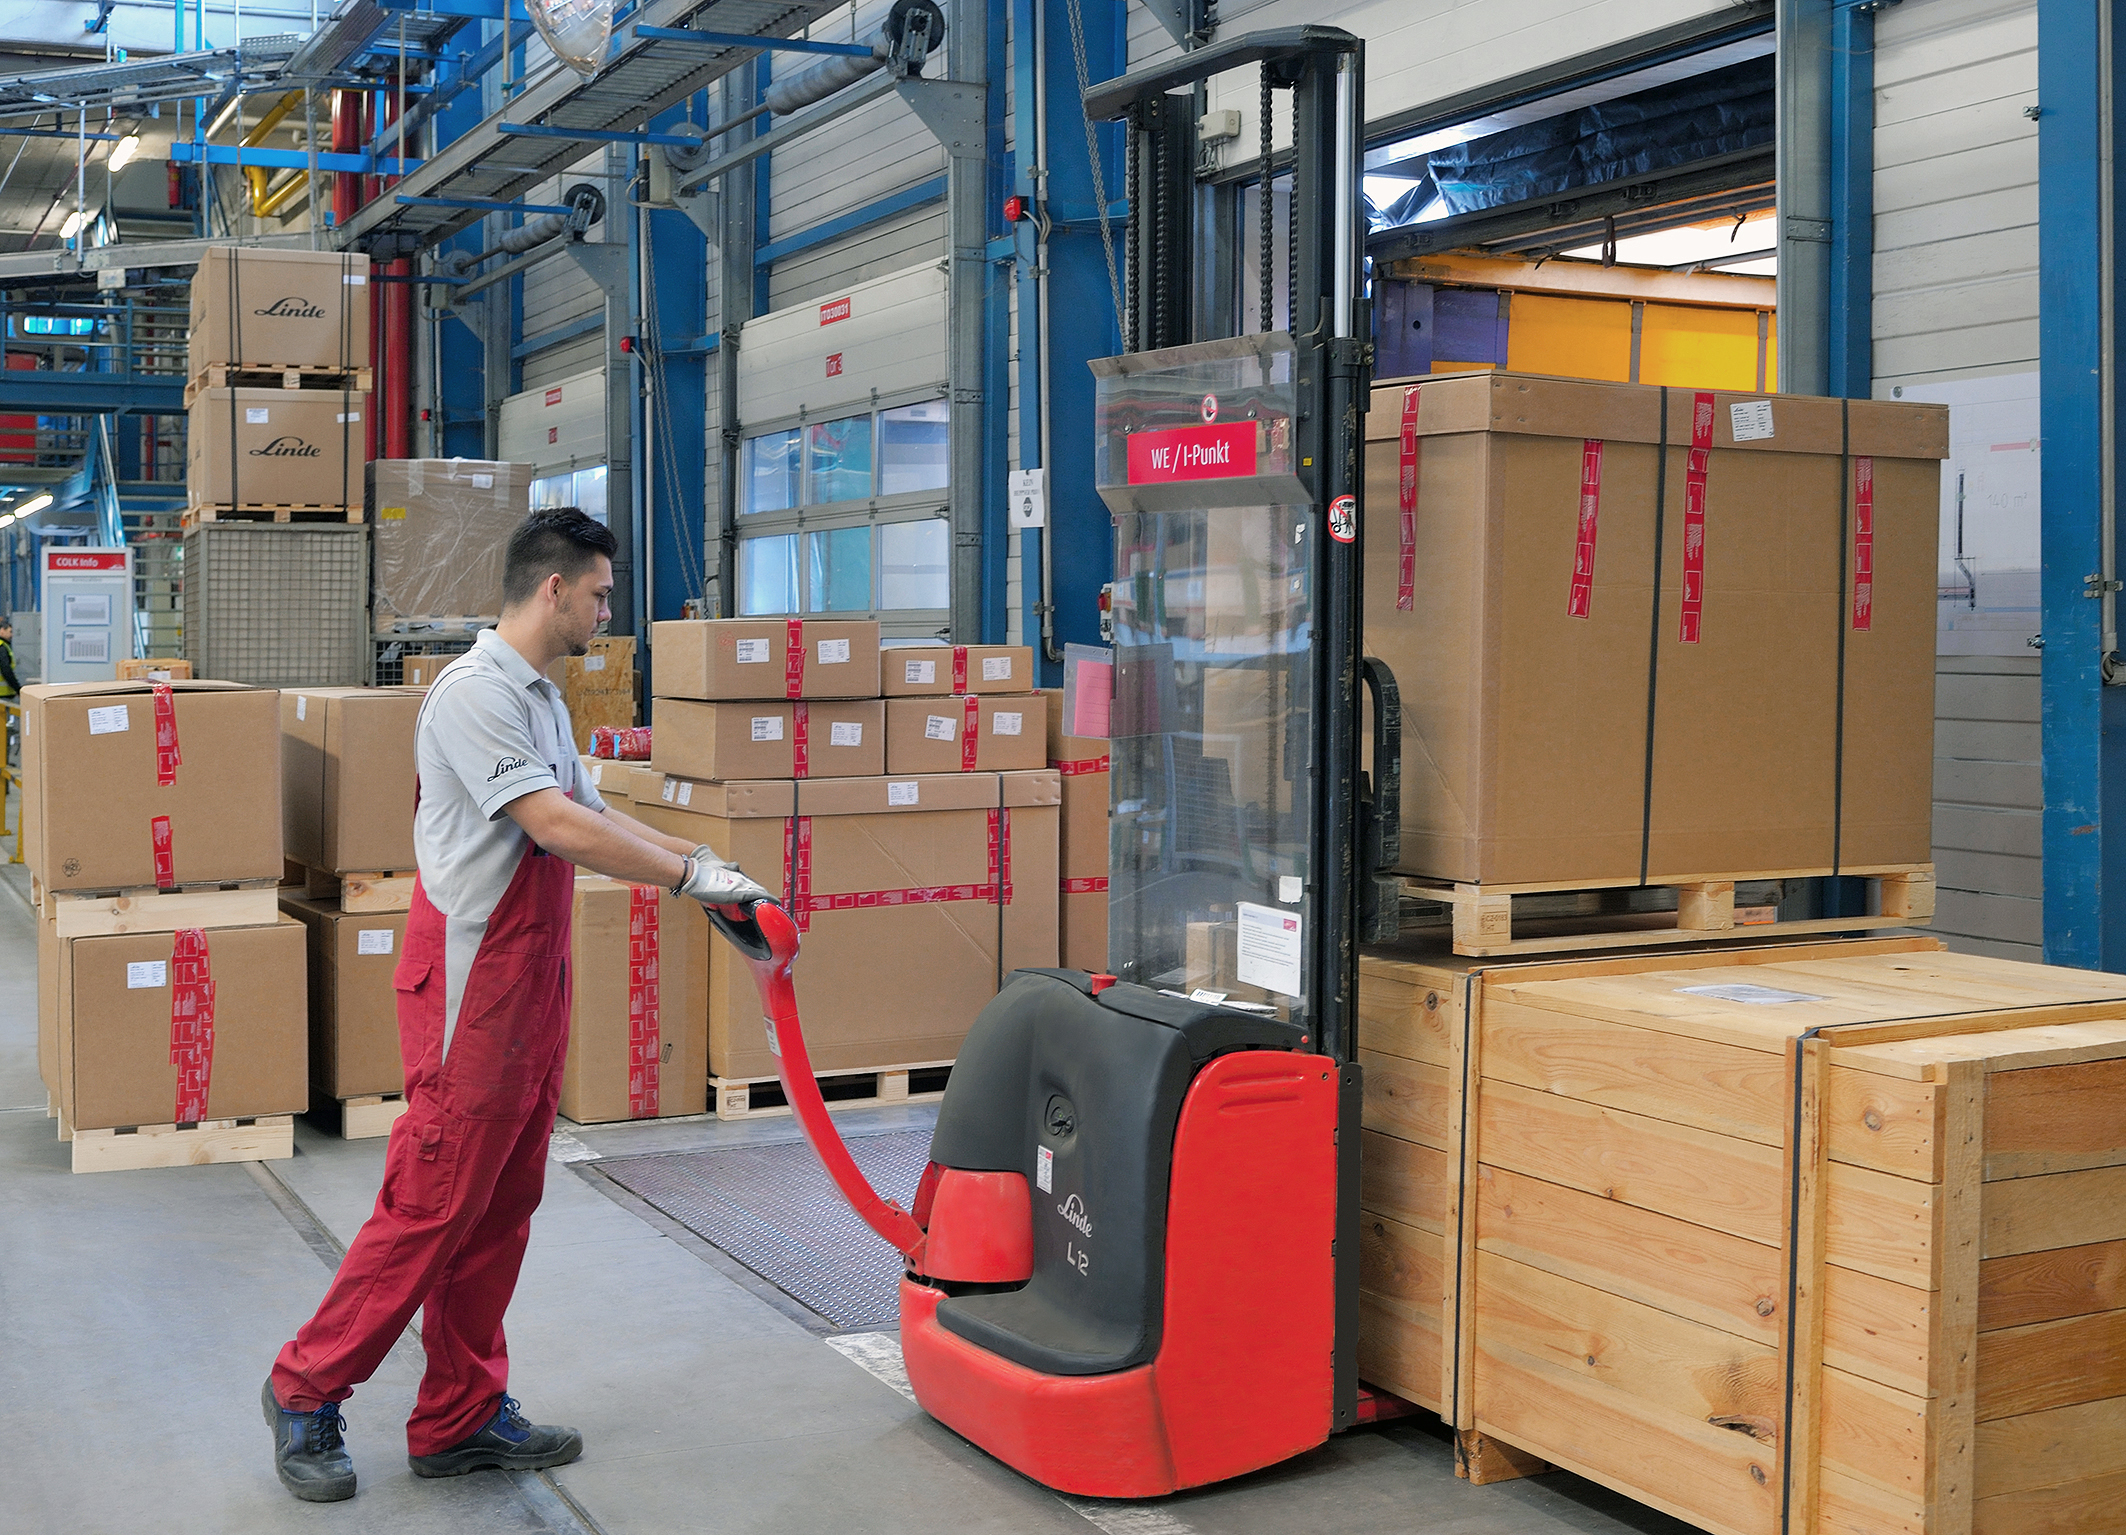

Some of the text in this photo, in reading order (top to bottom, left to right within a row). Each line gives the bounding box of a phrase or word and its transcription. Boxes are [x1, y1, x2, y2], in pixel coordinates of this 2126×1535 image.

[254, 296, 326, 319] Linde
[249, 436, 321, 457] Linde
[1150, 446, 1171, 470] WE
[1183, 438, 1230, 467] I-Punkt
[55, 557, 99, 568] COLK Info
[487, 756, 528, 782] Linde
[1057, 1193, 1093, 1238] Linde
